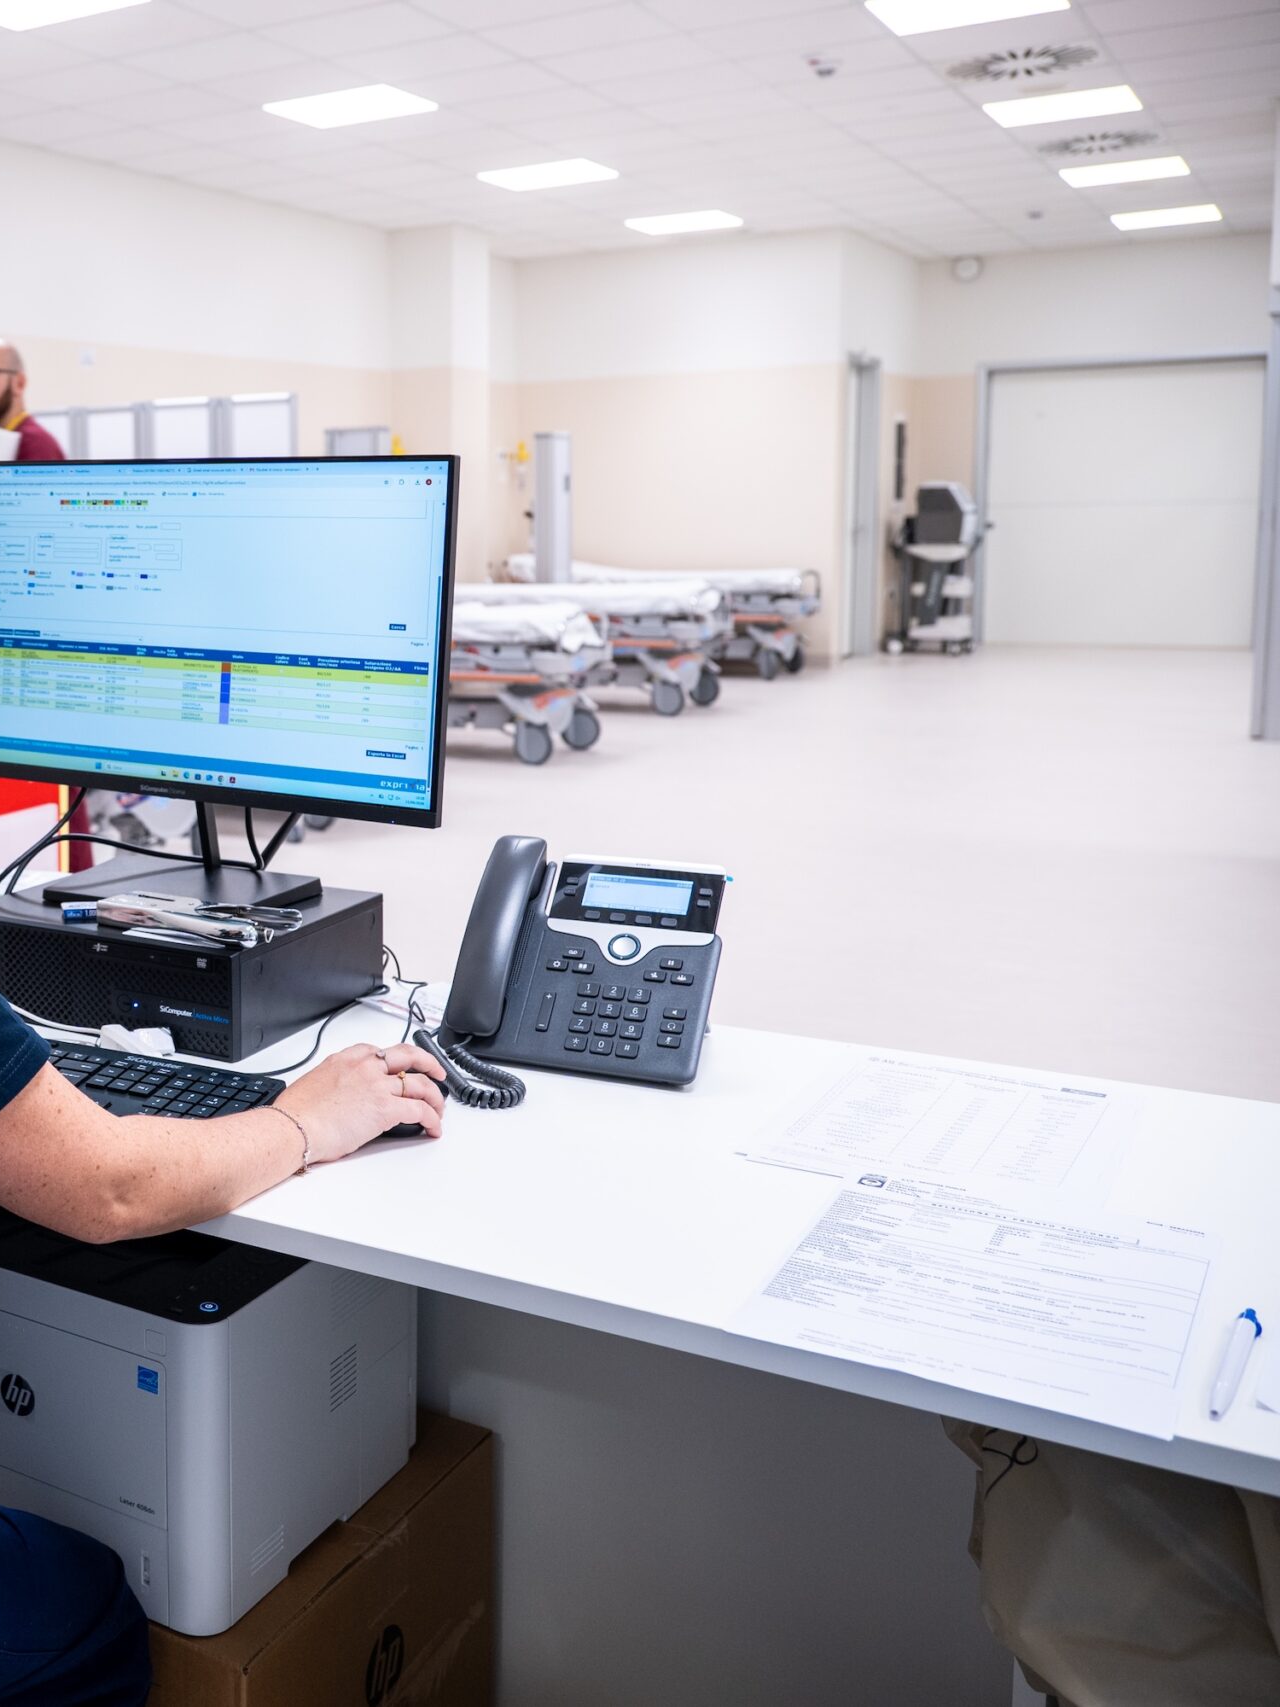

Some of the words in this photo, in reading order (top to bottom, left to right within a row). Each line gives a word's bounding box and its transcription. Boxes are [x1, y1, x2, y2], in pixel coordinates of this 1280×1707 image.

[159, 1005, 193, 1017] SiComputer
[577, 1018, 584, 1026] 7
[597, 1040, 605, 1048] 0
[5, 1374, 31, 1415] hp
[119, 1496, 135, 1508] Laser
